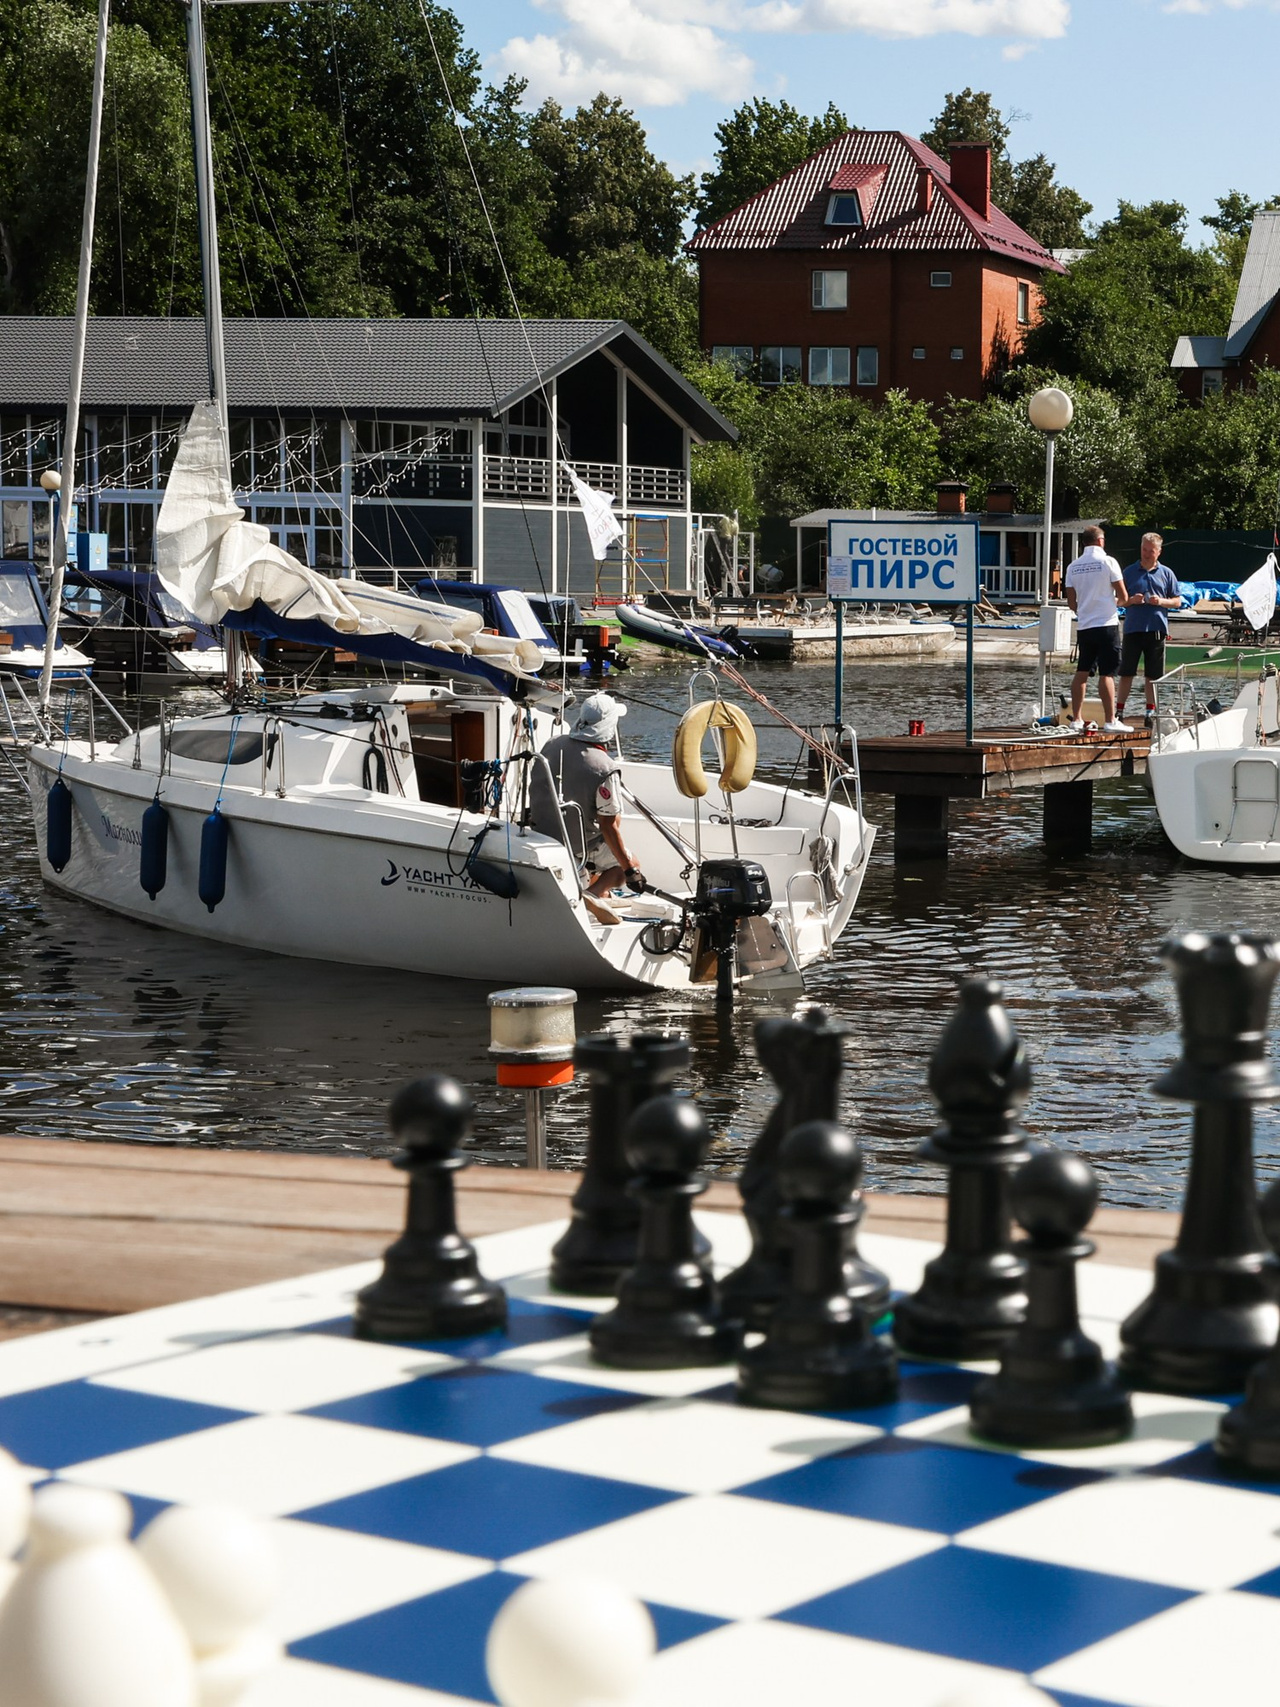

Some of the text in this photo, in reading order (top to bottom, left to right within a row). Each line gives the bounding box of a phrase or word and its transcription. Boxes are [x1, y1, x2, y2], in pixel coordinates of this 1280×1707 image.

[848, 533, 958, 556] ГОСТЕВОЙ
[851, 559, 955, 589] ПИРС
[402, 866, 481, 890] YACHT YA
[756, 884, 763, 895] 6
